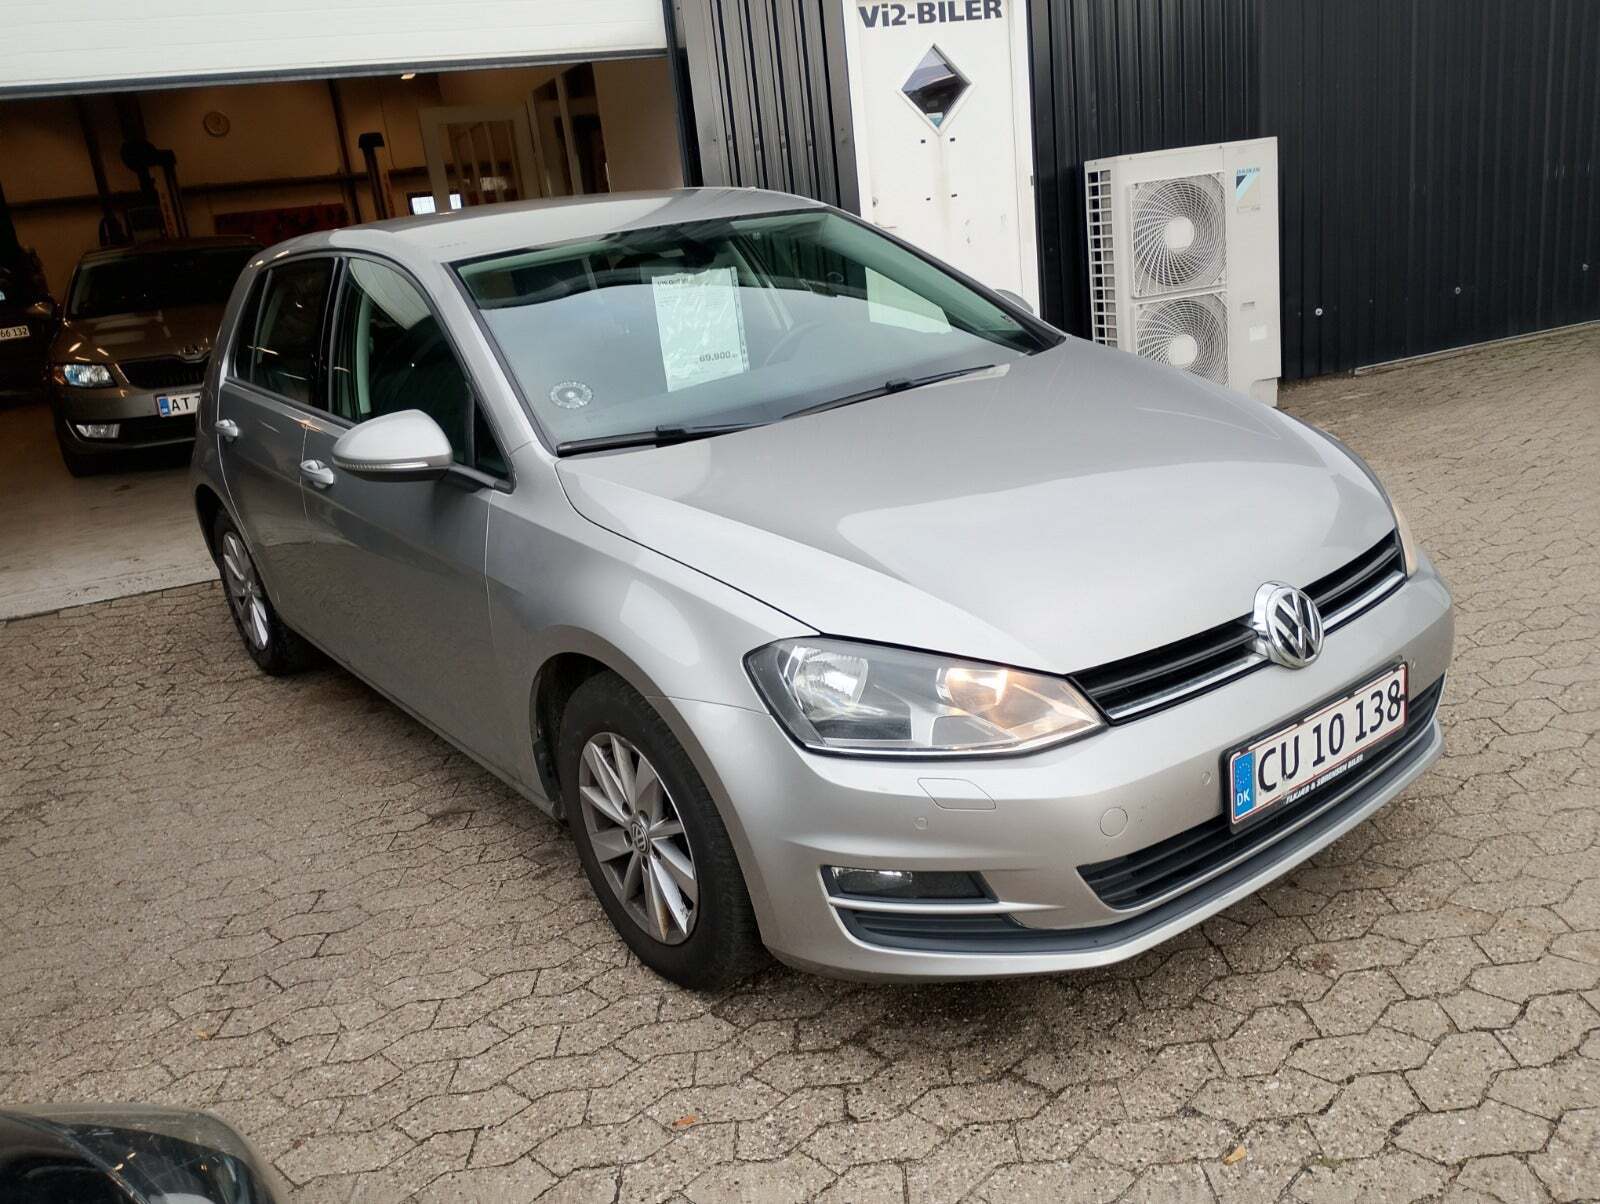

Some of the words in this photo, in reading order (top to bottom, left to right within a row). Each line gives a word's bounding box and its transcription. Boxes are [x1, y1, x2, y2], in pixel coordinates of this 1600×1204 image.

[858, 0, 1002, 28] Vi2-BILER
[172, 397, 190, 412] AT
[1257, 735, 1300, 793] CU
[1312, 712, 1345, 767] 10
[1354, 679, 1402, 743] 138
[1236, 789, 1251, 807] DK
